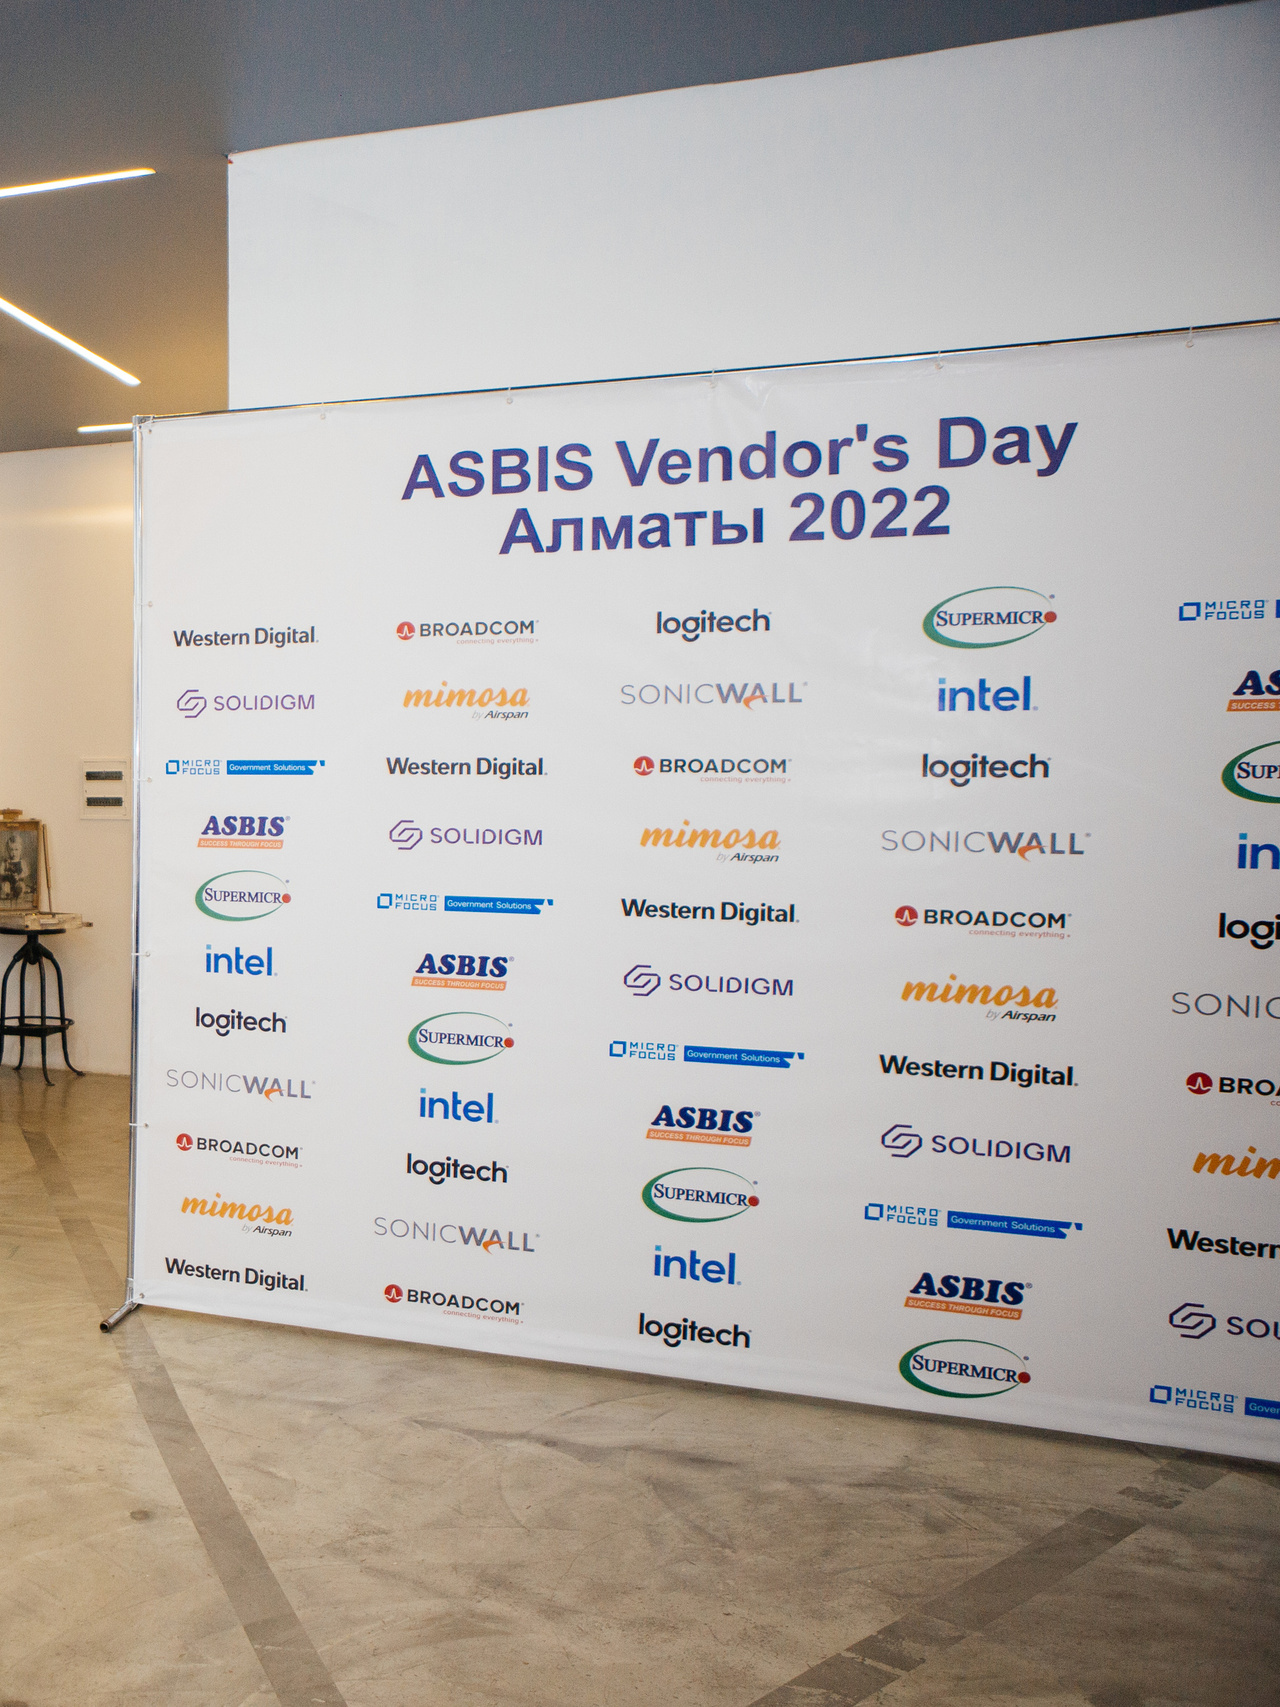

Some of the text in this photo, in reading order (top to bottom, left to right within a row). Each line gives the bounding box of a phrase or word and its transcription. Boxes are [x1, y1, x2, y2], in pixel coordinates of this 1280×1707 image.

[401, 416, 1078, 500] ASBIS Vendor's Day
[499, 485, 951, 555] Алматы 2022
[1205, 600, 1265, 610] MICRO
[1205, 610, 1265, 621] FOCUS
[419, 620, 535, 637] BROADCOM
[656, 608, 770, 642] logitech
[173, 629, 250, 647] Western
[456, 637, 495, 645] connecting
[213, 694, 315, 711] SOLIDIGM
[403, 680, 530, 708] mimosa
[620, 682, 803, 708] SONICWALL
[938, 675, 1031, 712] intel
[1231, 701, 1275, 711] SUCCESS
[471, 710, 529, 721] by Airspan
[182, 759, 220, 767] MICRO
[182, 767, 220, 775] FOCUS
[229, 763, 306, 771] Government Solutions
[386, 756, 471, 775] Western
[659, 758, 787, 774] BROADCOM
[922, 753, 1050, 788] logitech
[1236, 761, 1280, 780] SUP
[700, 774, 743, 784] connecting
[200, 839, 228, 847] SUCCESS
[229, 840, 260, 848] THROUGH
[430, 827, 543, 846] SOLIDIGM
[639, 819, 781, 850] mimosa
[881, 829, 1085, 859] SONICWALL
[716, 851, 779, 864] by Airspan
[395, 893, 437, 902] MICRO
[395, 902, 437, 911] FOCUS
[447, 899, 532, 910] Government Solutions
[621, 898, 715, 920] Western
[923, 908, 1066, 929] BROADCOM
[968, 928, 1017, 938] connecting
[205, 944, 273, 976] intel
[414, 978, 505, 990] SUCCESS THROUGH FOCUS
[669, 973, 794, 996] SOLIDIGM
[900, 973, 1059, 1009] mimosa
[195, 1006, 287, 1037] logitech
[985, 1009, 1057, 1024] by Airspan
[629, 1041, 676, 1051] MICRO
[629, 1050, 676, 1061] FOCUS
[686, 1050, 781, 1063] Government Solutions
[879, 1053, 984, 1080] Western
[166, 1069, 312, 1101] SONICWALL
[419, 1087, 494, 1124] intel
[649, 1130, 749, 1146] SUCCESS THROUGH FOCUS
[196, 1137, 299, 1160] BROADCOM
[931, 1135, 1071, 1164] SOLIDIGM
[229, 1155, 264, 1166] connecting
[407, 1152, 508, 1185] logitech
[181, 1192, 294, 1226] mimosa
[887, 1204, 938, 1217] MICRO
[887, 1214, 938, 1227] FOCUS
[950, 1215, 1056, 1233] Government Solutions
[241, 1224, 292, 1237] by Airspan
[374, 1216, 535, 1254] SONICWALL
[1167, 1228, 1280, 1260] Western
[165, 1256, 240, 1283] Western
[654, 1245, 736, 1285] intel
[407, 1288, 520, 1316] BROADCOM
[908, 1299, 1020, 1319] SUCCESS THROUGH FOCUS
[443, 1308, 481, 1320] connecting
[638, 1312, 751, 1349] logitech
[1175, 1387, 1235, 1404] MICRO
[1175, 1397, 1234, 1413] FOCUS
